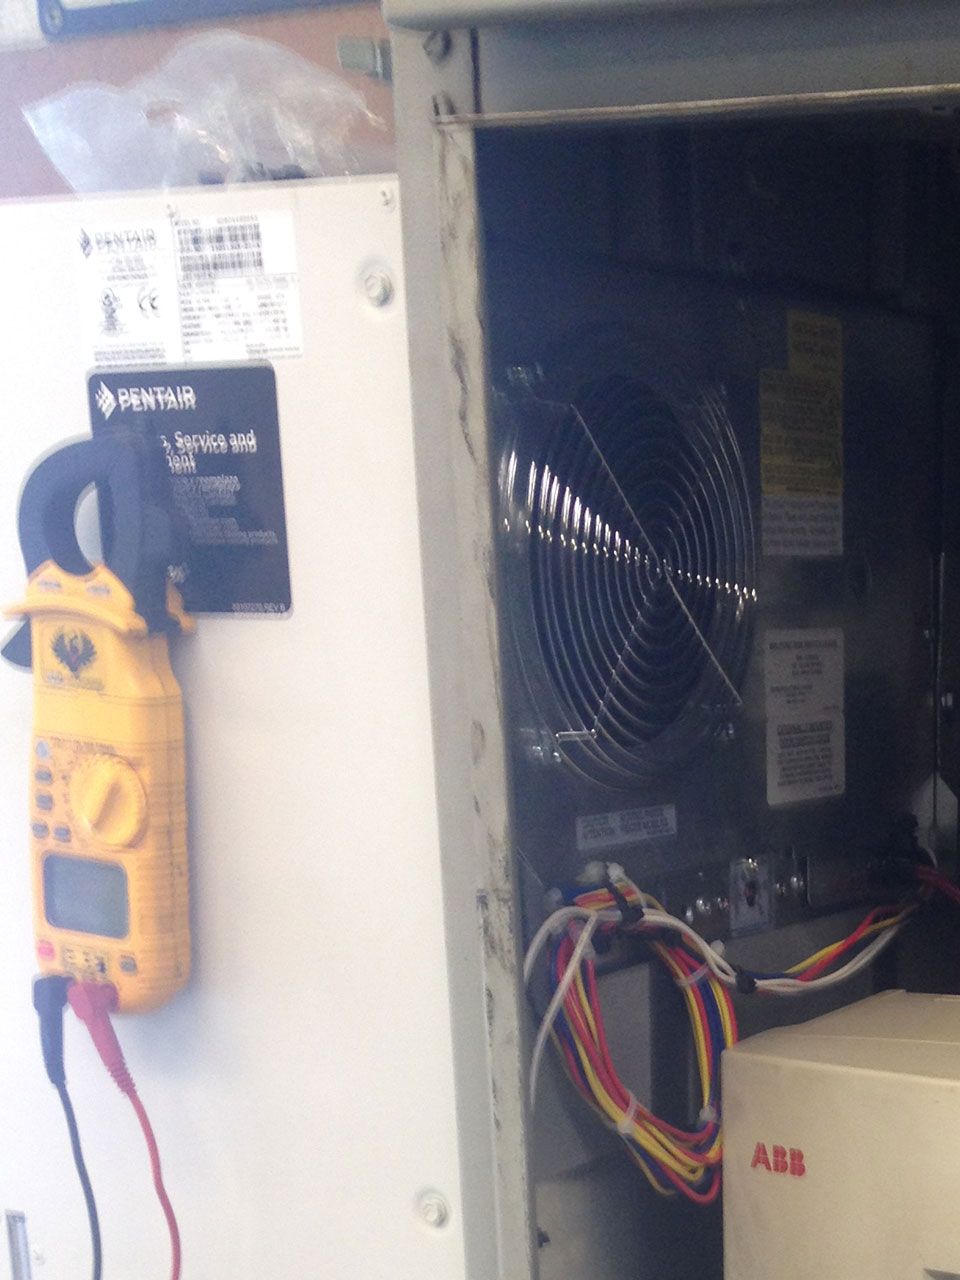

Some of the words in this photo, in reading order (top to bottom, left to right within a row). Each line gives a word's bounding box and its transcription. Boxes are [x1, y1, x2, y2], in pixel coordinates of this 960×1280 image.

[95, 228, 157, 252] PENTAIR
[118, 386, 196, 412] PENTAIR
[174, 431, 227, 454] Service
[229, 430, 257, 454] and
[751, 1142, 806, 1177] ABB
